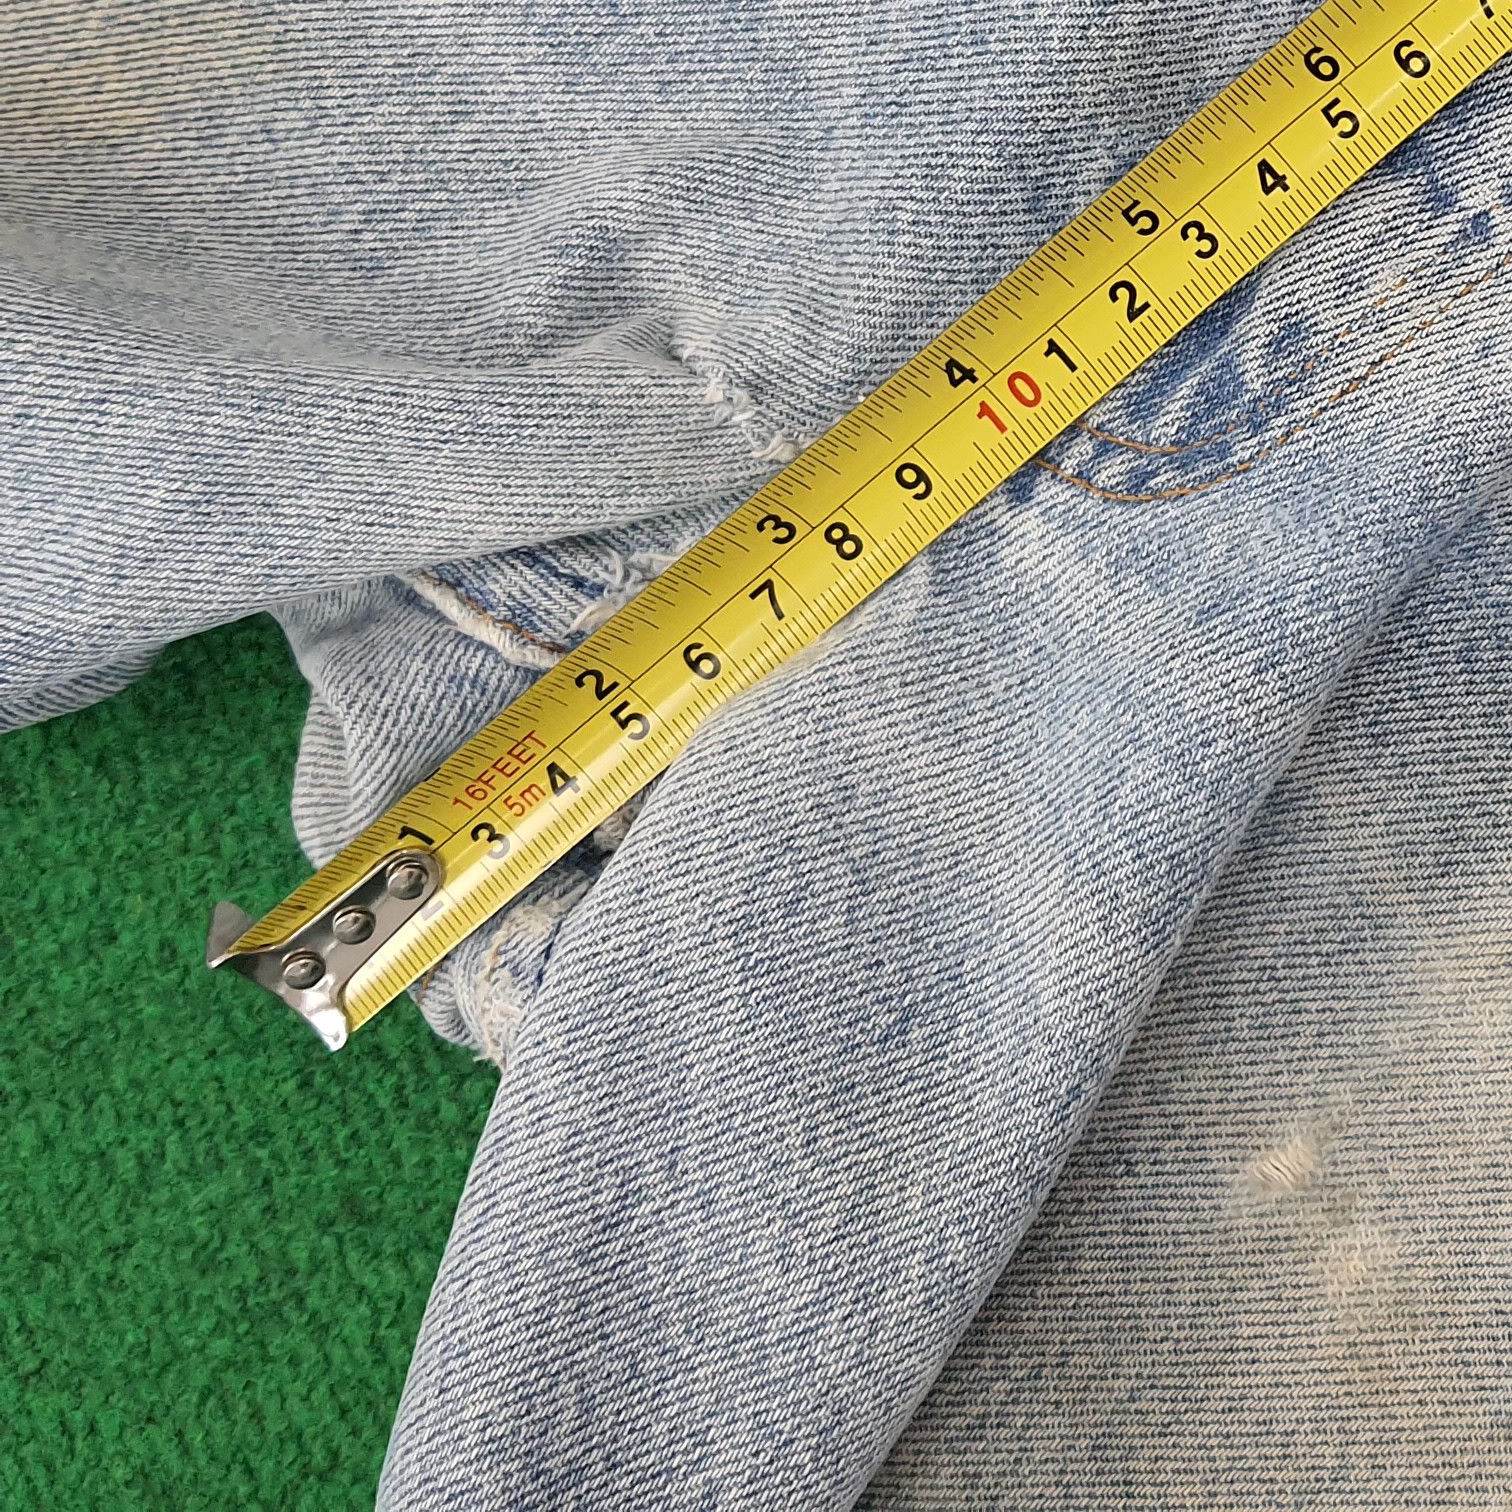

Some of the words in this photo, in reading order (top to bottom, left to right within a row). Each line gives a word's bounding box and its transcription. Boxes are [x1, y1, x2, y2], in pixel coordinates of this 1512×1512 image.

[398, 825, 435, 846] 1
[452, 729, 548, 811] 16FEET
[575, 667, 620, 703] 2
[755, 513, 797, 544] 3
[944, 357, 978, 389] 4
[1121, 199, 1160, 236] 5
[1302, 45, 1340, 82] 6
[470, 822, 511, 860] 3
[503, 783, 547, 817] 5m
[546, 760, 582, 798] 4
[609, 700, 652, 742] 5
[682, 641, 722, 681] 6
[748, 579, 787, 622] 7
[823, 522, 864, 563] 8
[893, 460, 934, 502] 9
[976, 370, 1042, 434] 10
[1043, 338, 1079, 374] 1
[1108, 280, 1151, 323] 2
[1180, 220, 1219, 260] 3
[1256, 158, 1290, 201] 4
[1320, 97, 1362, 140] 5
[1392, 39, 1432, 78] 6
